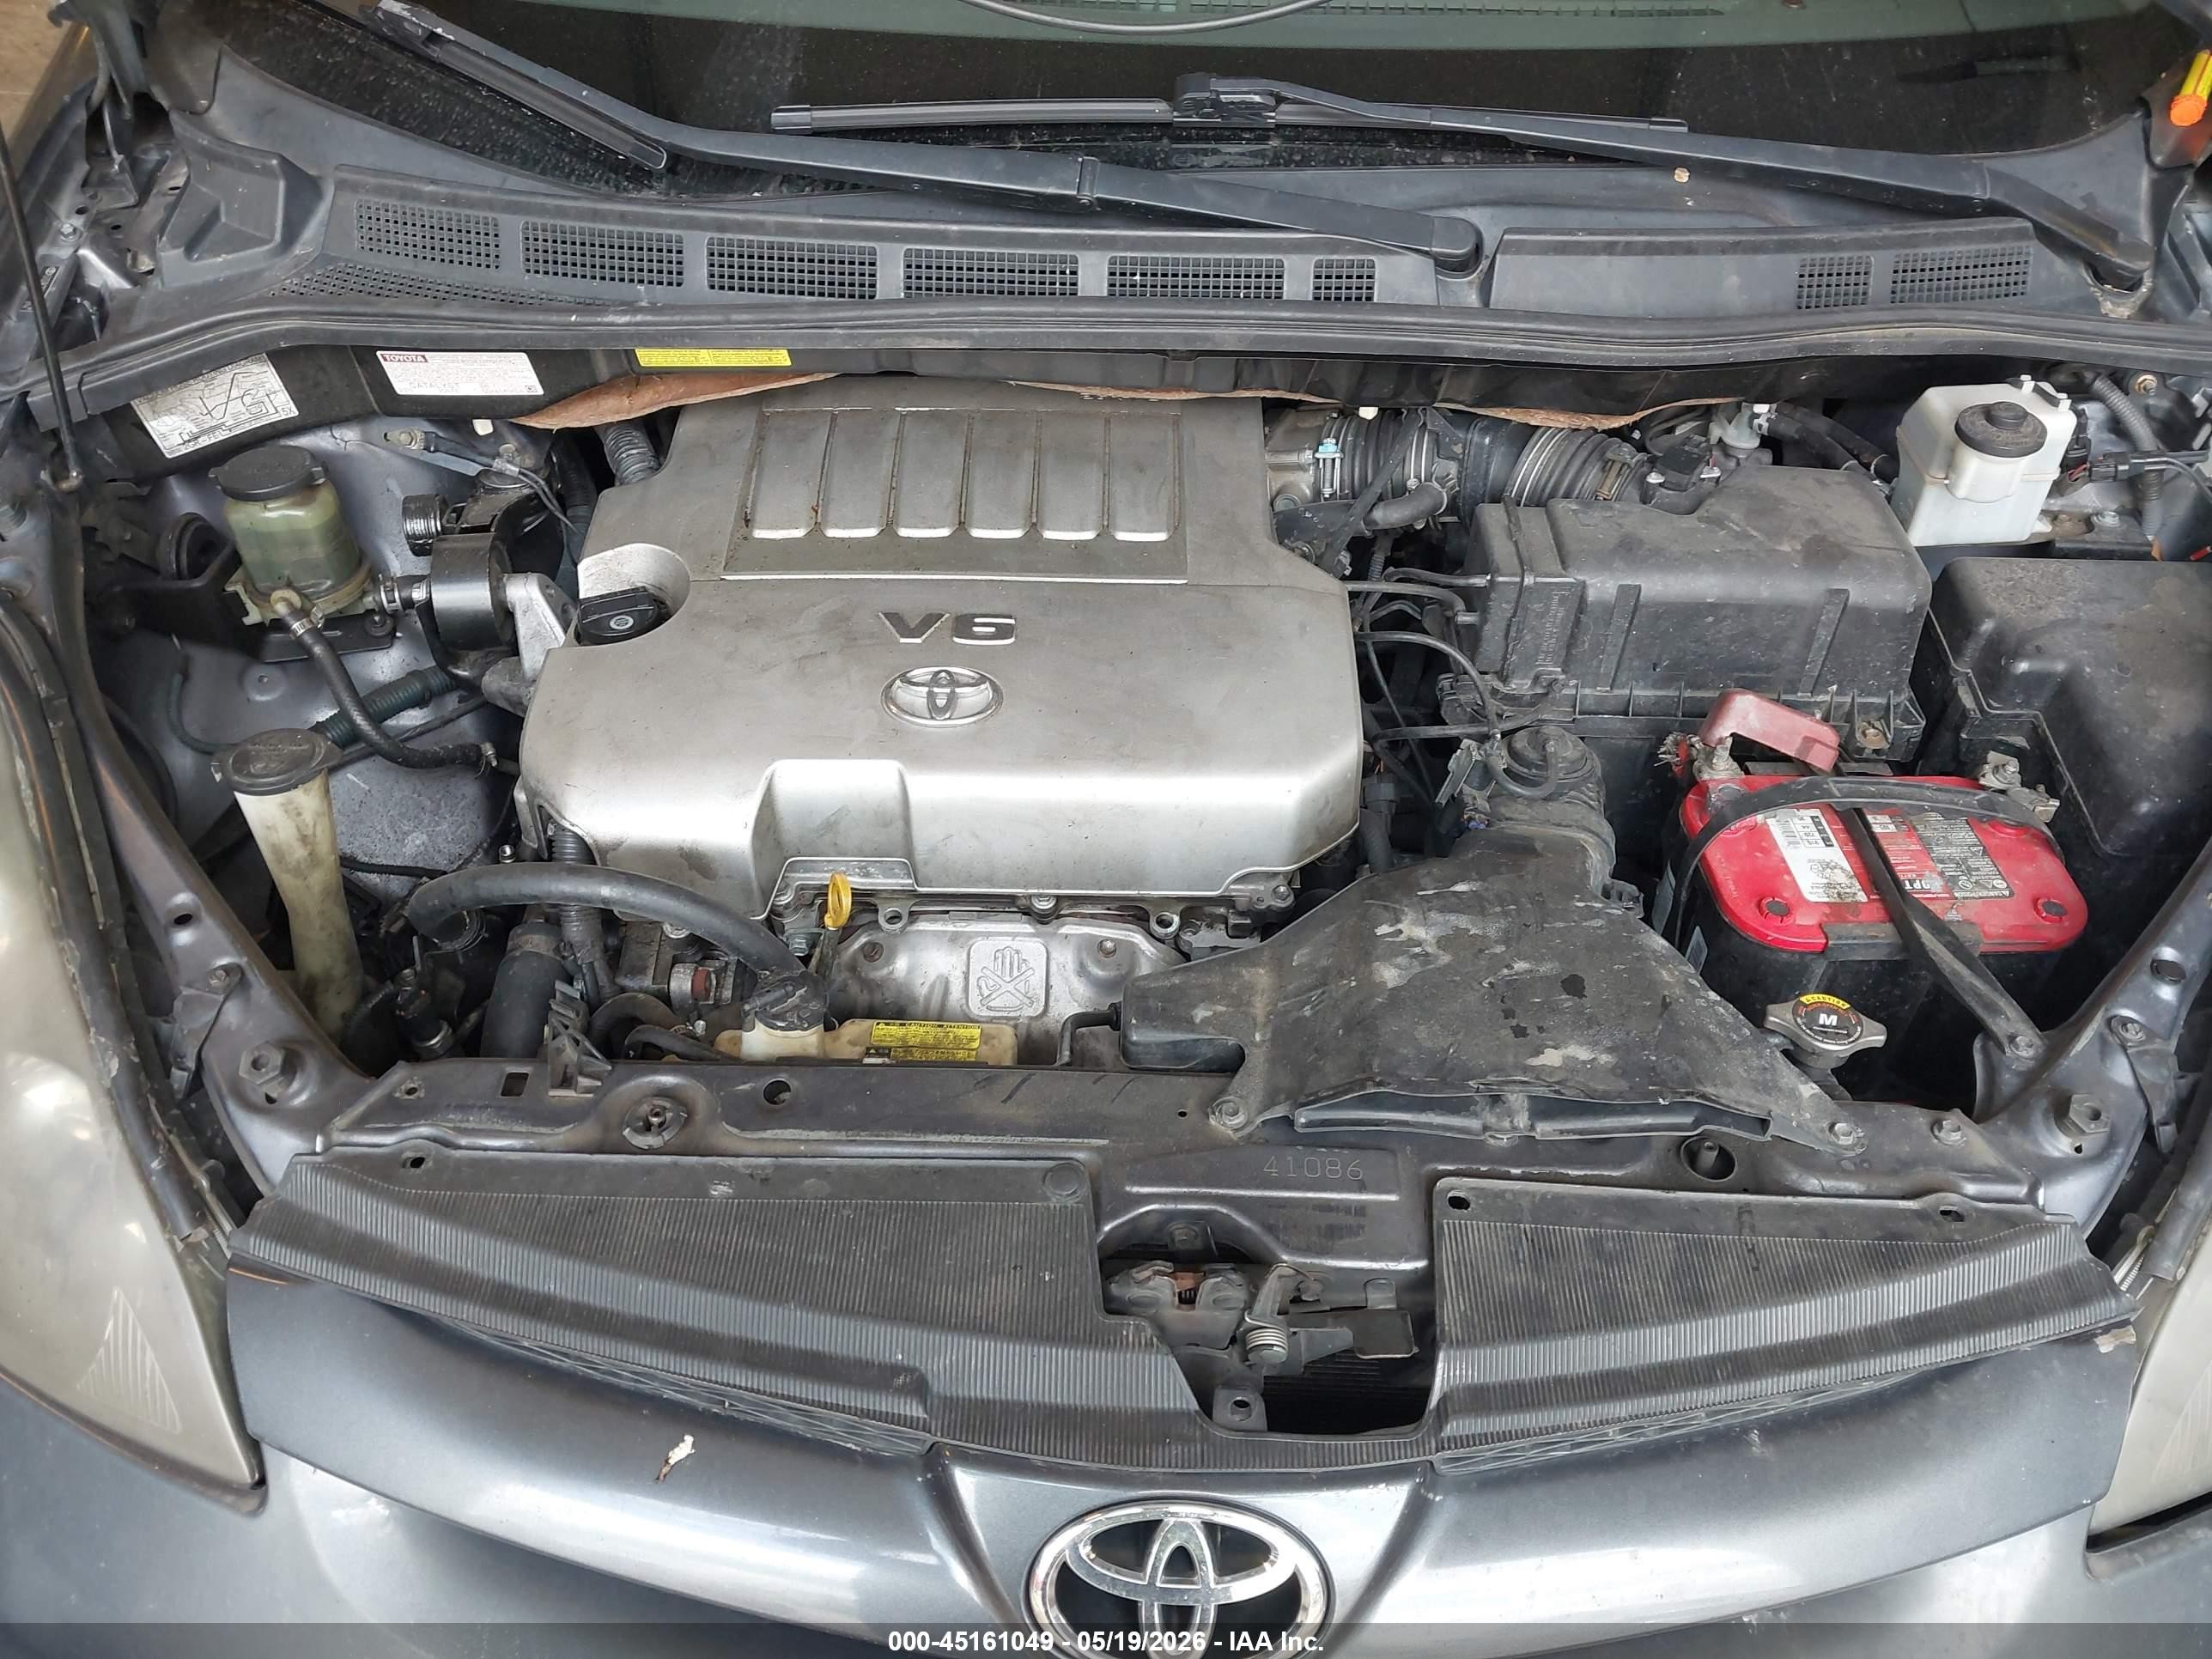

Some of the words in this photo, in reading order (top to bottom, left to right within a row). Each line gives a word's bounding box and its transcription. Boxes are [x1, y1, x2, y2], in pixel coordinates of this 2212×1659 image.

[384, 354, 427, 363] TOYOTA
[878, 611, 1017, 646] V6
[1811, 995, 1847, 1007] CAUTION
[1819, 1013, 1838, 1026] M
[1263, 1155, 1364, 1180] 41086
